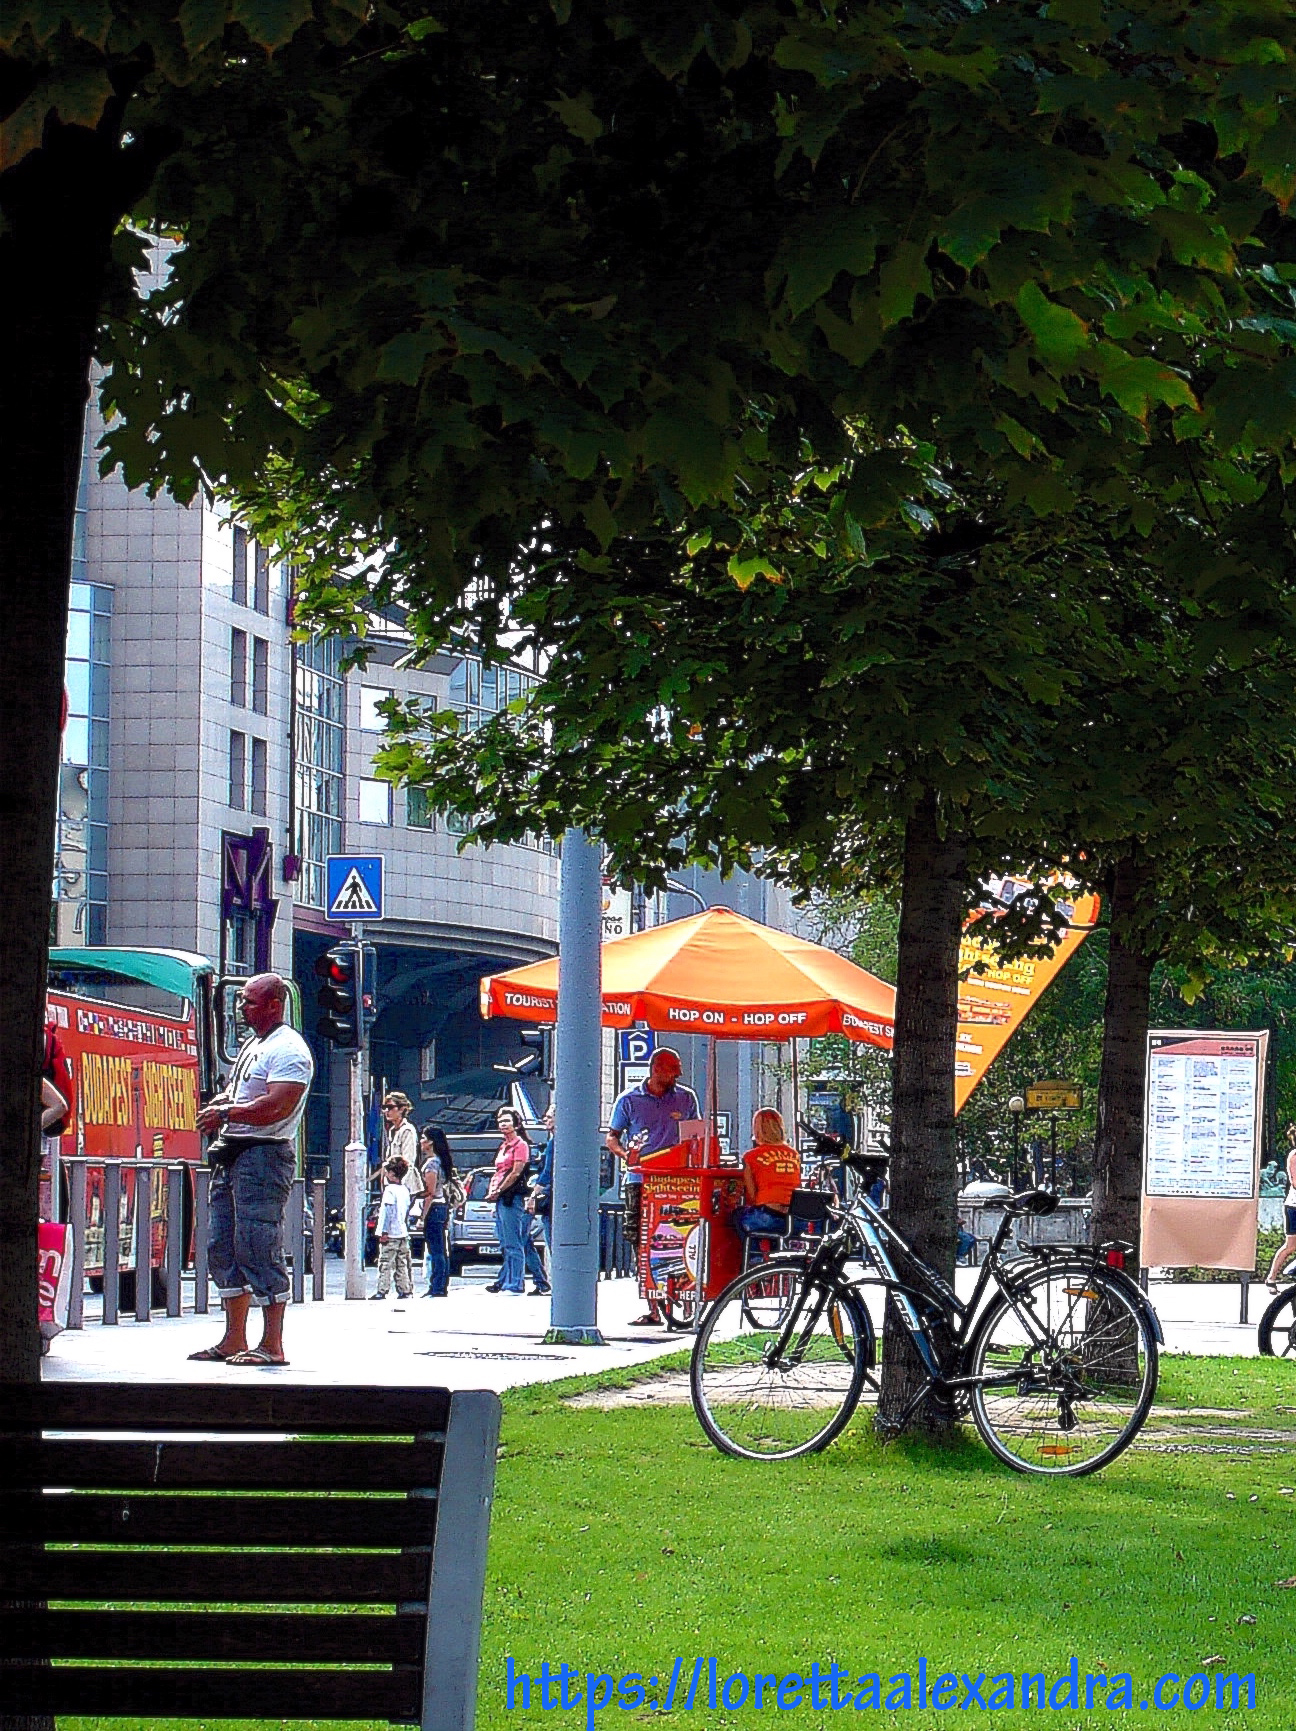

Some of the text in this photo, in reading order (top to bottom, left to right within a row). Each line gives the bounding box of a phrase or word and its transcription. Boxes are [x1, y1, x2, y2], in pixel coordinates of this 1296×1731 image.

[505, 993, 555, 1009] TOURIST
[669, 1008, 700, 1021] HOP
[702, 1011, 724, 1023] ON
[744, 1012, 775, 1024] HOP
[778, 1012, 807, 1024] OFF
[630, 1041, 648, 1061] P
[82, 1052, 197, 1132] BUDAPEST SIGHTSEEING
[650, 1175, 700, 1185] Budapest
